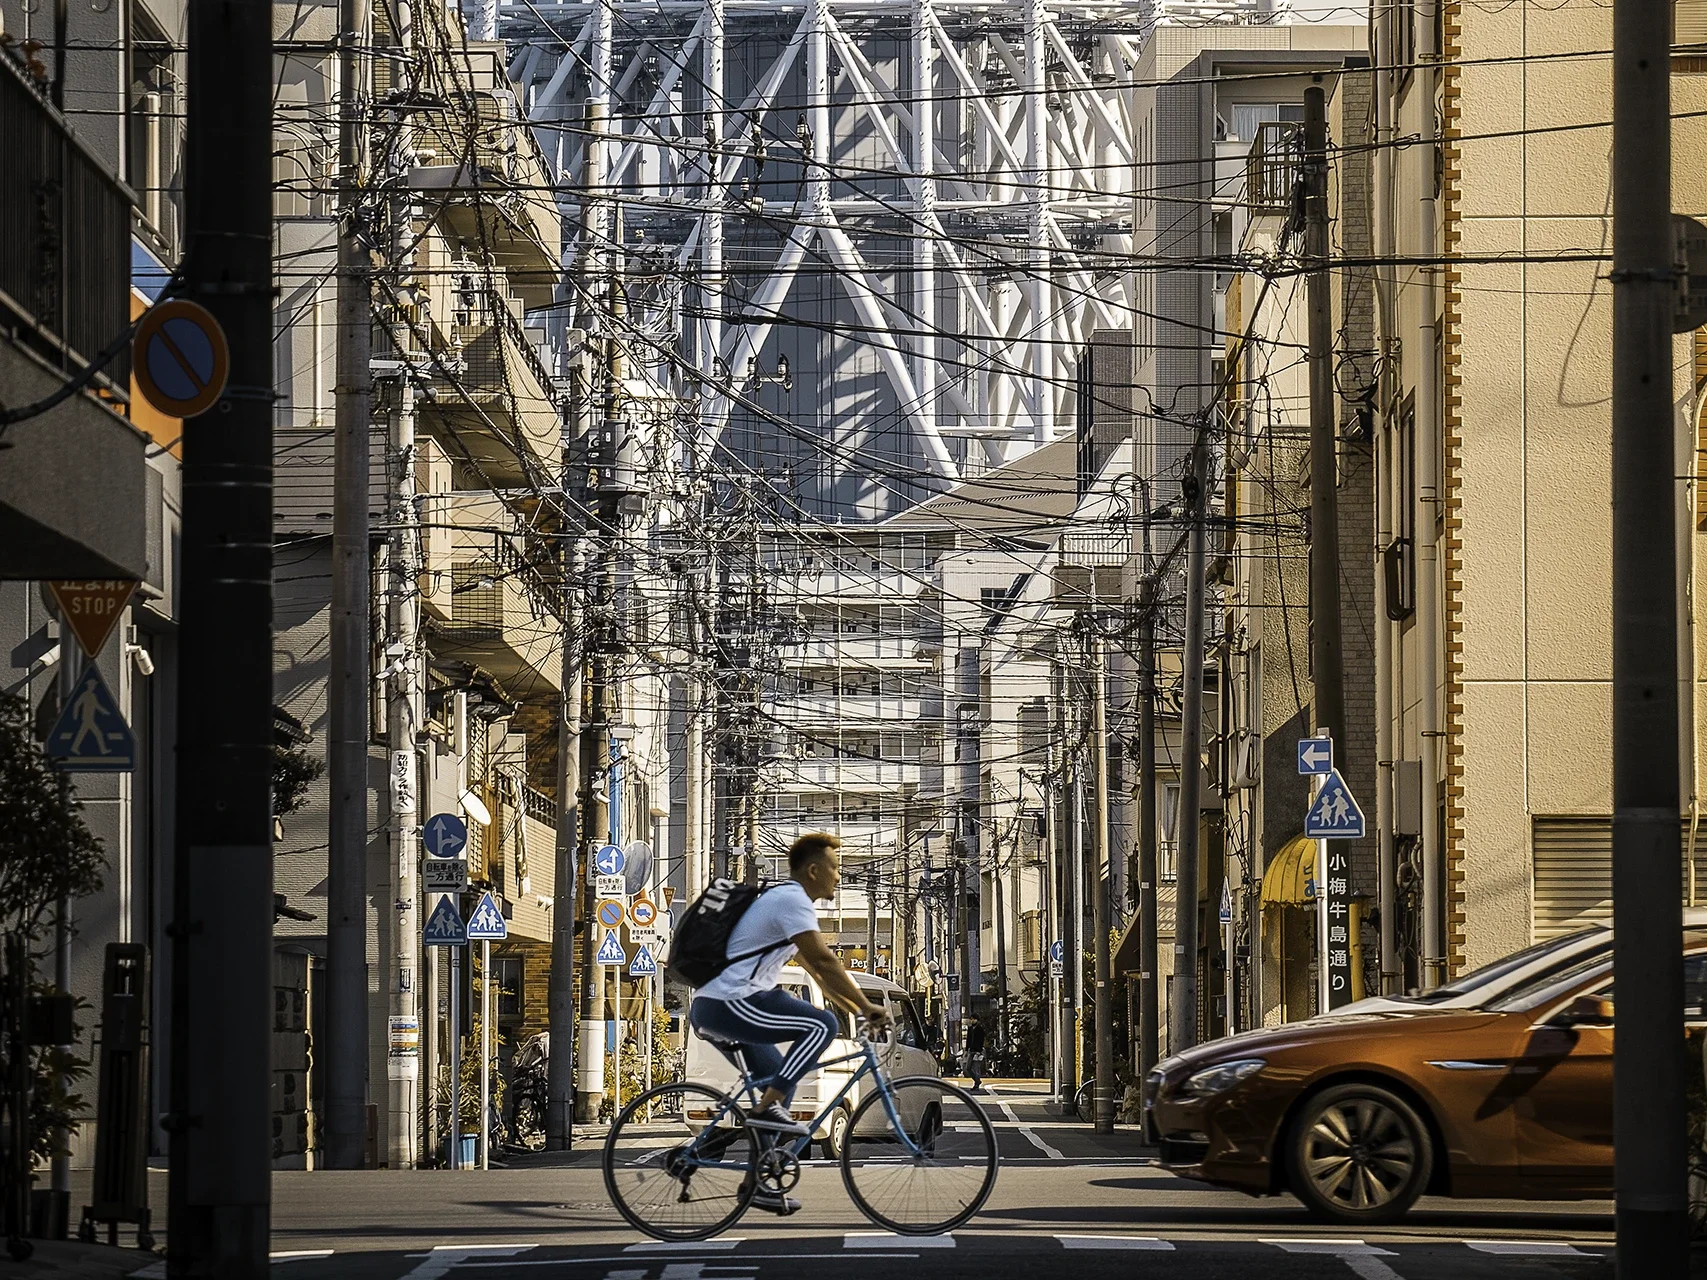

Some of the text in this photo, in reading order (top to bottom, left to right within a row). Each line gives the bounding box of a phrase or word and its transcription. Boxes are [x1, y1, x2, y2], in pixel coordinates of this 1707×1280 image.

[71, 596, 116, 615] STOP
[426, 862, 464, 872] 自転車を除く
[426, 872, 464, 881] 一方通行
[1329, 853, 1347, 991] 小梅牛島通り
